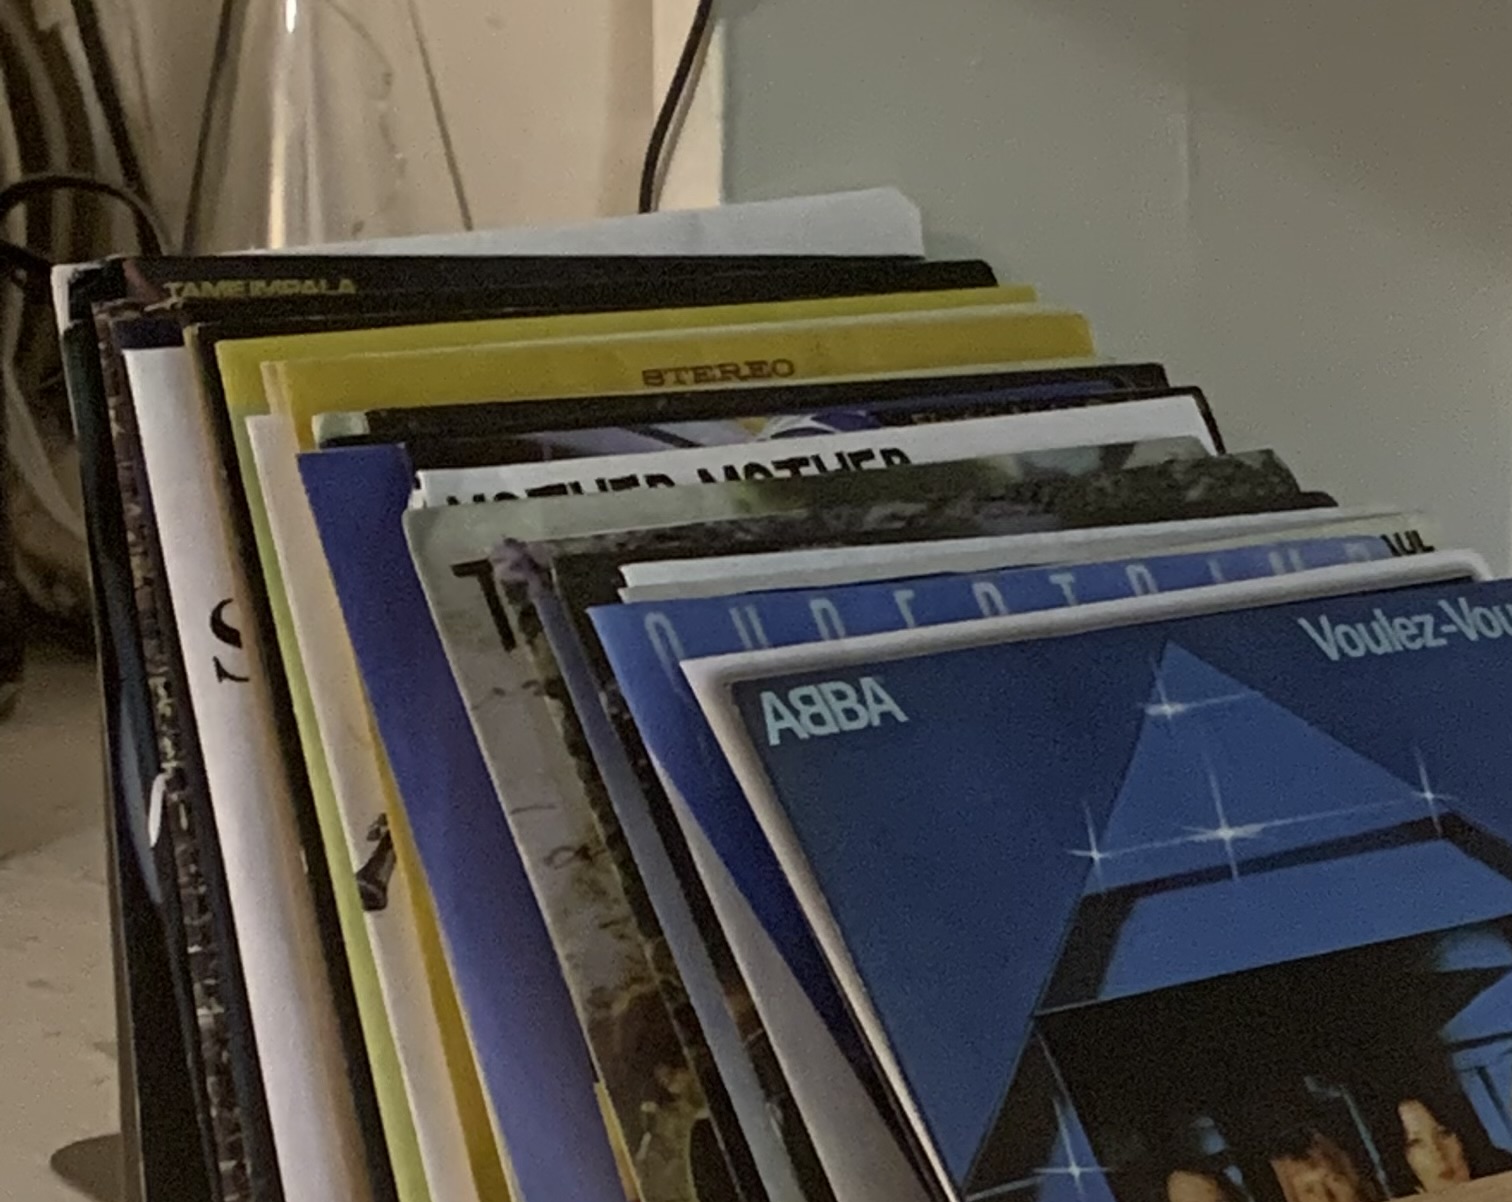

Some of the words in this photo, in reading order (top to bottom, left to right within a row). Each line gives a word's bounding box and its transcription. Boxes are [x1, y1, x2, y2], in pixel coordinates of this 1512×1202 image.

[163, 280, 245, 298] TAME
[249, 278, 357, 297] IMPALA
[641, 358, 796, 388] STEREO
[759, 676, 909, 746] ABBA
